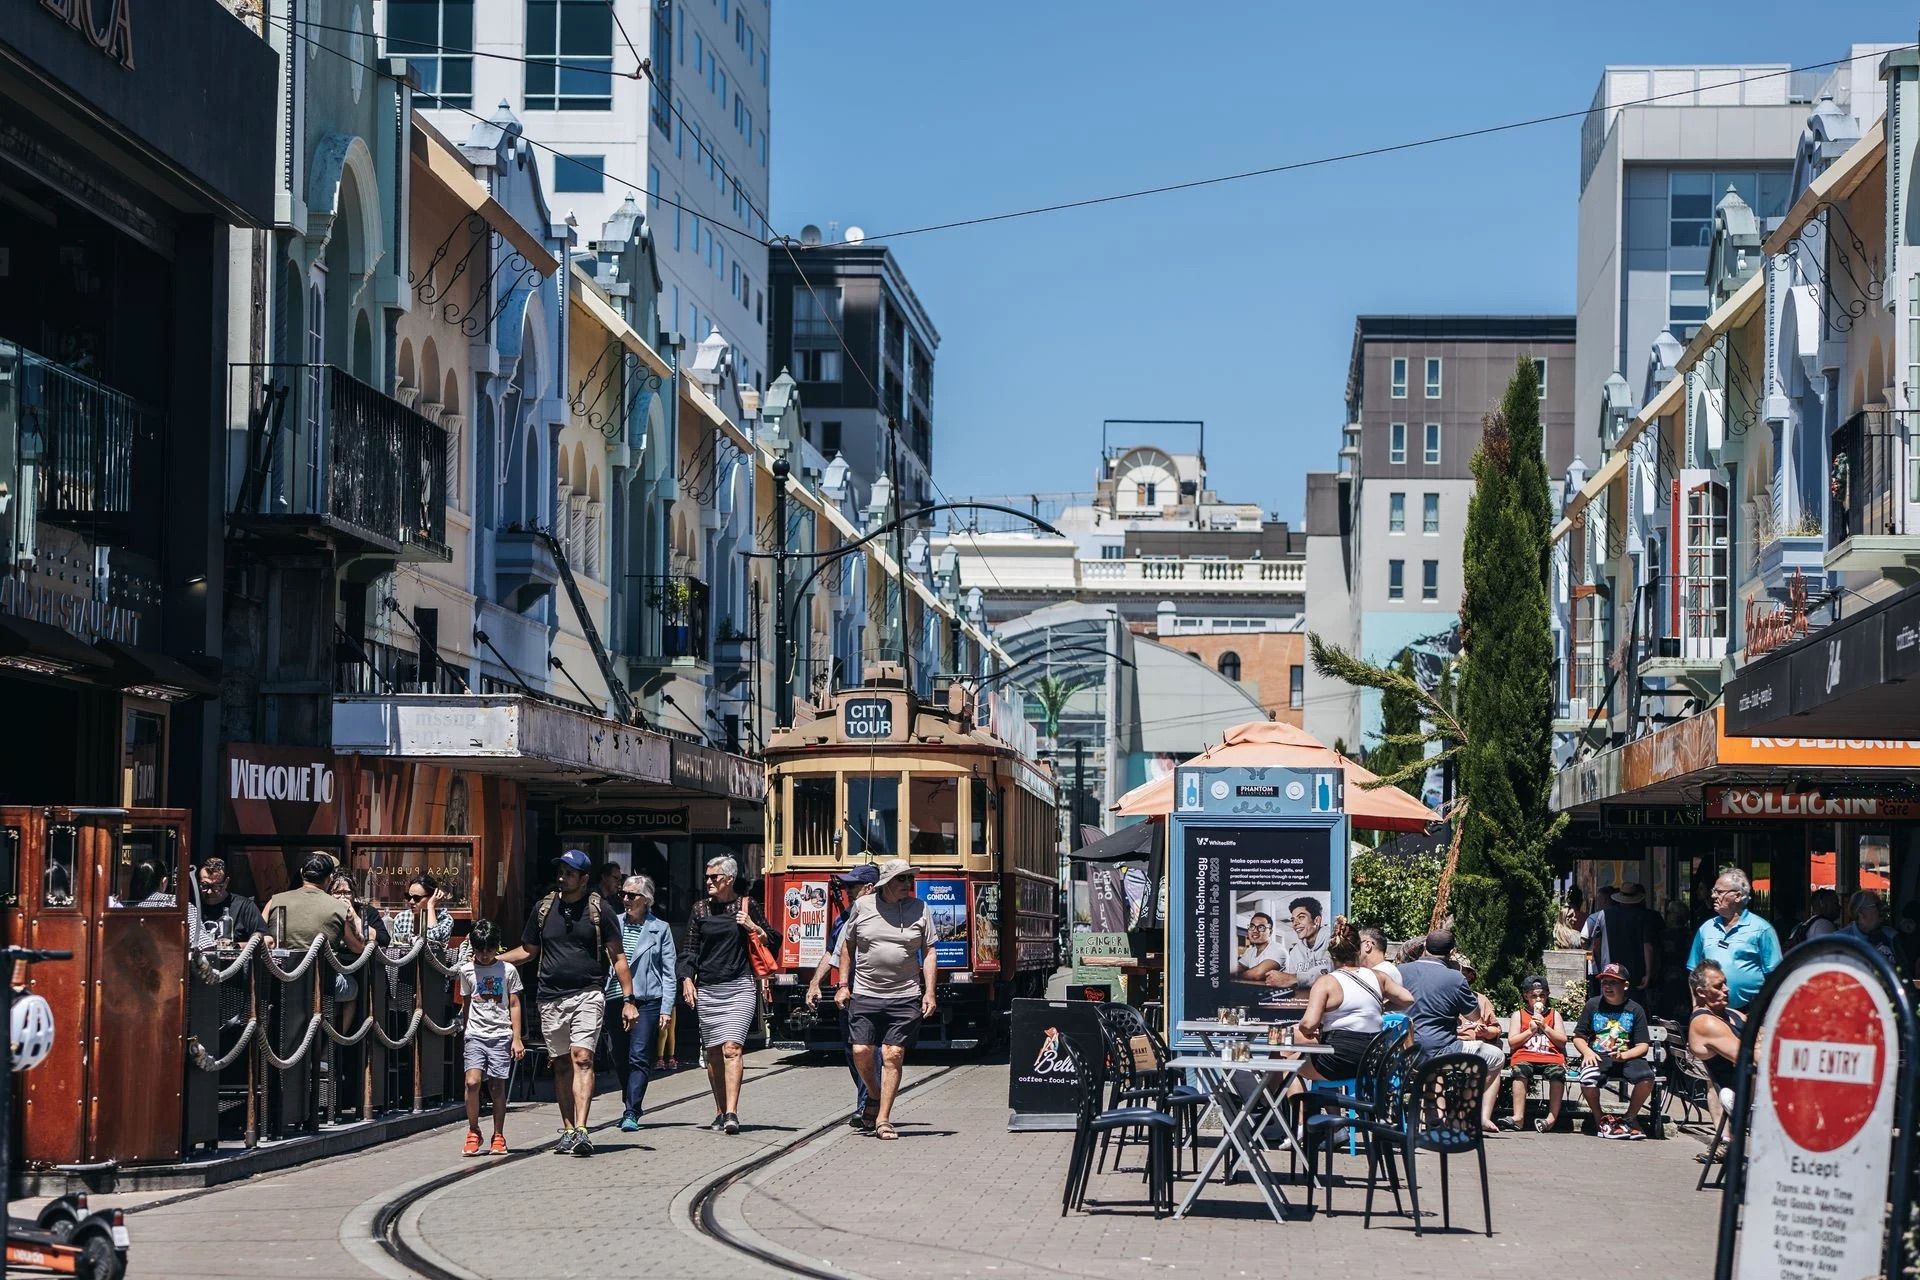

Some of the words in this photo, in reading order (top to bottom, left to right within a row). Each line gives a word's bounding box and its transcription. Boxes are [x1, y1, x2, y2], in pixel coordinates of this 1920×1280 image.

[851, 705, 887, 718] CITY
[847, 721, 892, 734] TOUR
[231, 758, 310, 802] WELCOME
[1721, 791, 1877, 815] ROLLICKIN
[565, 814, 623, 825] TATTOO
[626, 814, 682, 825] STUDIO
[1628, 809, 1655, 825] THE
[1210, 857, 1219, 883] 2023
[1103, 870, 1113, 900] OPEN
[1195, 857, 1208, 915] Technology
[927, 893, 956, 901] GONDOLA
[1210, 884, 1219, 904] Feb
[802, 909, 825, 925] QUAKE
[1210, 906, 1219, 916] in
[805, 923, 821, 937] CITY
[1087, 936, 1123, 947] GINGER
[1195, 917, 1206, 977] Information
[1209, 918, 1219, 975] Whitecliffe
[1075, 946, 1103, 955] BREAD
[1108, 946, 1130, 955] MAN
[1211, 976, 1219, 988] at
[1791, 1047, 1809, 1072] NO
[1818, 1048, 1861, 1076] ENTRY
[1049, 1075, 1064, 1084] food
[1790, 1156, 1841, 1179] Except
[1776, 1181, 1799, 1194] Trams
[1801, 1185, 1811, 1195] At
[1814, 1186, 1830, 1199] Any
[1833, 1188, 1853, 1200] Time
[1772, 1196, 1787, 1207] And
[1790, 1198, 1815, 1211] Goods
[1820, 1201, 1855, 1215] Vehicles
[1775, 1211, 1789, 1222] For
[1792, 1213, 1824, 1228] Loading
[1825, 1217, 1847, 1231] Only
[1816, 1260, 1838, 1273] Area
